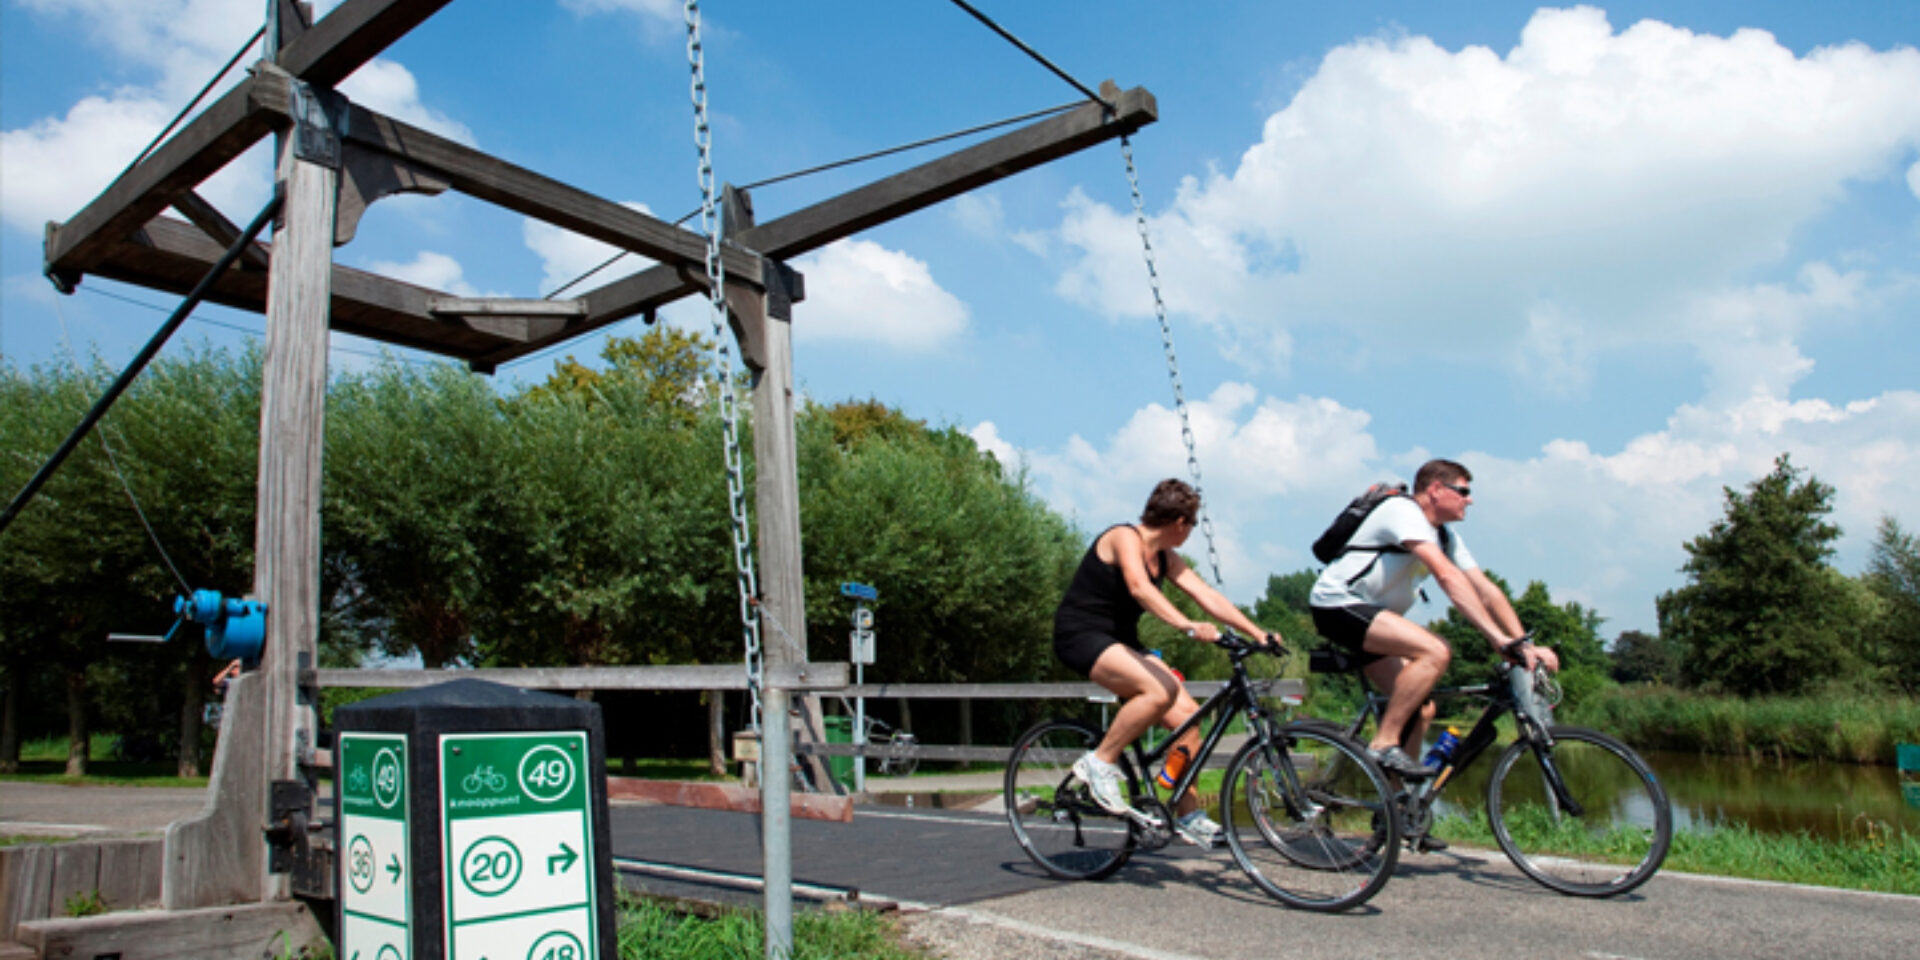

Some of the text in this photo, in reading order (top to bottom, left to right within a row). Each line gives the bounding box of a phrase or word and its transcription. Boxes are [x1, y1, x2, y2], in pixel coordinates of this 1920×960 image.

[377, 764, 396, 793] 49
[528, 760, 566, 788] 49
[353, 850, 370, 879] 36
[470, 851, 512, 882] 20
